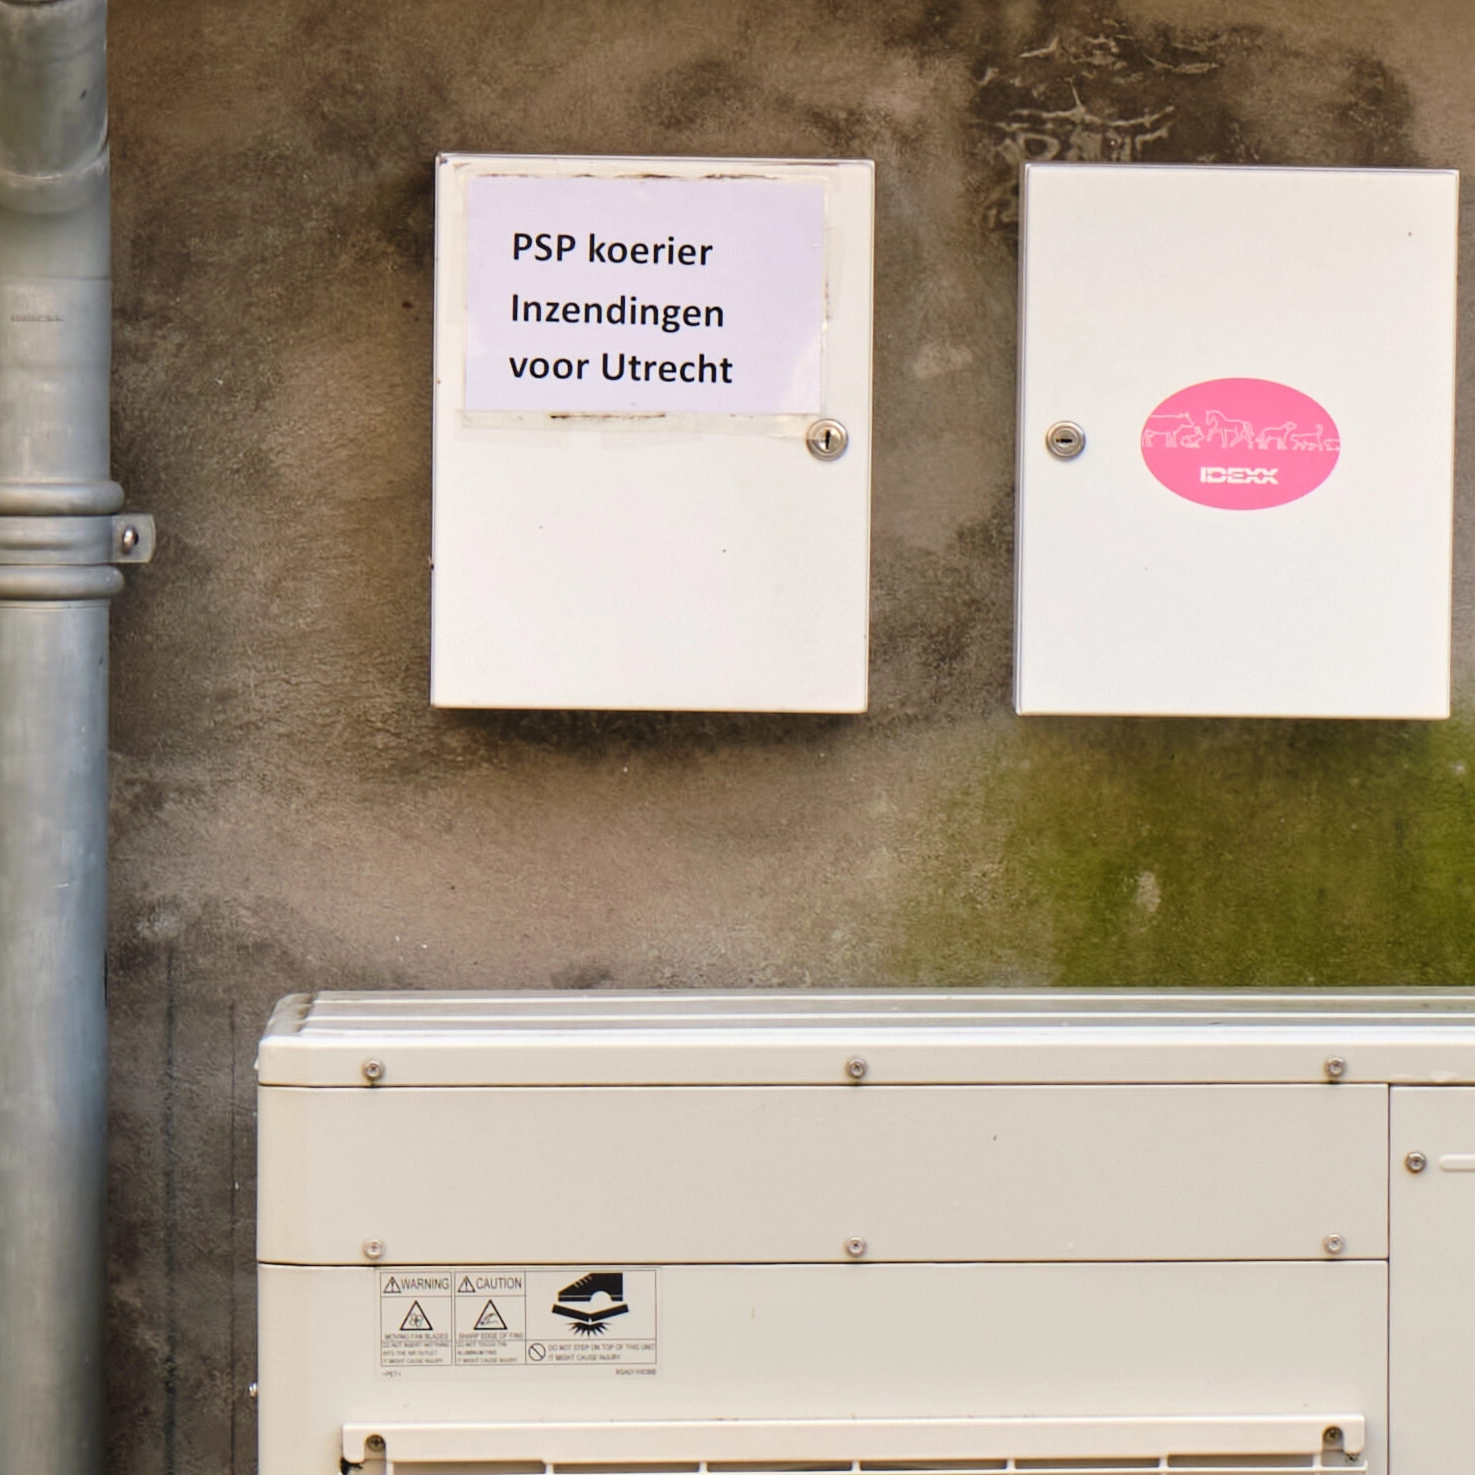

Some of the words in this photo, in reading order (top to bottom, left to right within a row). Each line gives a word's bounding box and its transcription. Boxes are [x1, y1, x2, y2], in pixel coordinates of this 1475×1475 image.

[512, 232, 576, 262] PSP
[588, 233, 714, 266] koerier
[511, 294, 725, 333] Inzendingen
[509, 356, 589, 380] voor
[602, 353, 734, 384] Utrecht
[1199, 466, 1279, 485] IDEXX
[401, 1277, 450, 1290] WARNING
[476, 1277, 523, 1290] CAUTION
[548, 1343, 558, 1351] DO
[559, 1343, 572, 1351] NOT
[574, 1343, 590, 1351] STEP
[602, 1343, 614, 1351] TOP
[615, 1343, 623, 1351] OF
[626, 1343, 639, 1351] THIS
